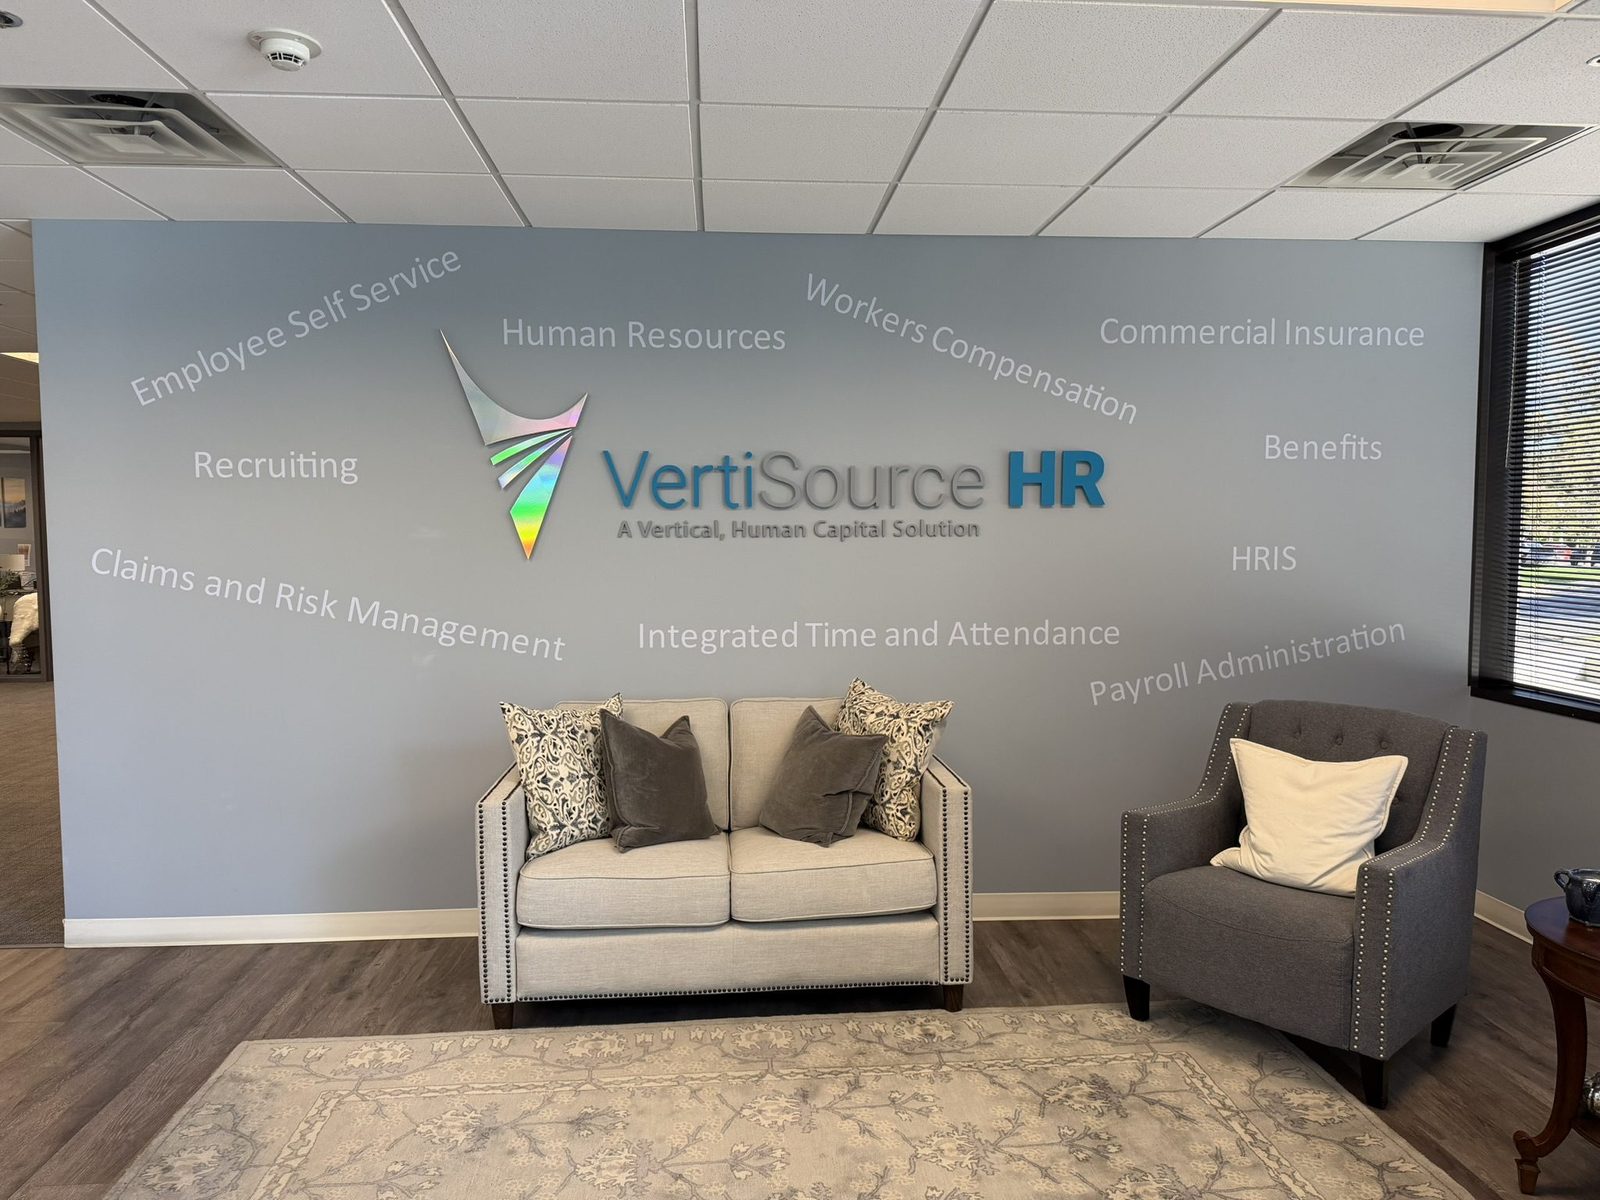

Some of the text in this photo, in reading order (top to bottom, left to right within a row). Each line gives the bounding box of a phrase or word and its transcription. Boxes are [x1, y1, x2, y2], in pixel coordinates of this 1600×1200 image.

[131, 251, 462, 407] Employee Self Service
[502, 318, 786, 351] Human Resources
[1100, 317, 1425, 347] Commercial Insurance
[807, 272, 1137, 425] Workers Compensation
[1264, 432, 1382, 461] Benefits
[194, 450, 359, 485] Recruiting
[602, 450, 1105, 510] VertiSource HR
[617, 519, 980, 542] A Vertical, Human Capital Solution
[1232, 545, 1297, 572] HRIS
[91, 547, 566, 662] Claims and Risk Management
[639, 618, 1120, 655] Integrated Time and Attendance
[1089, 623, 1406, 706] Payroll Administration
